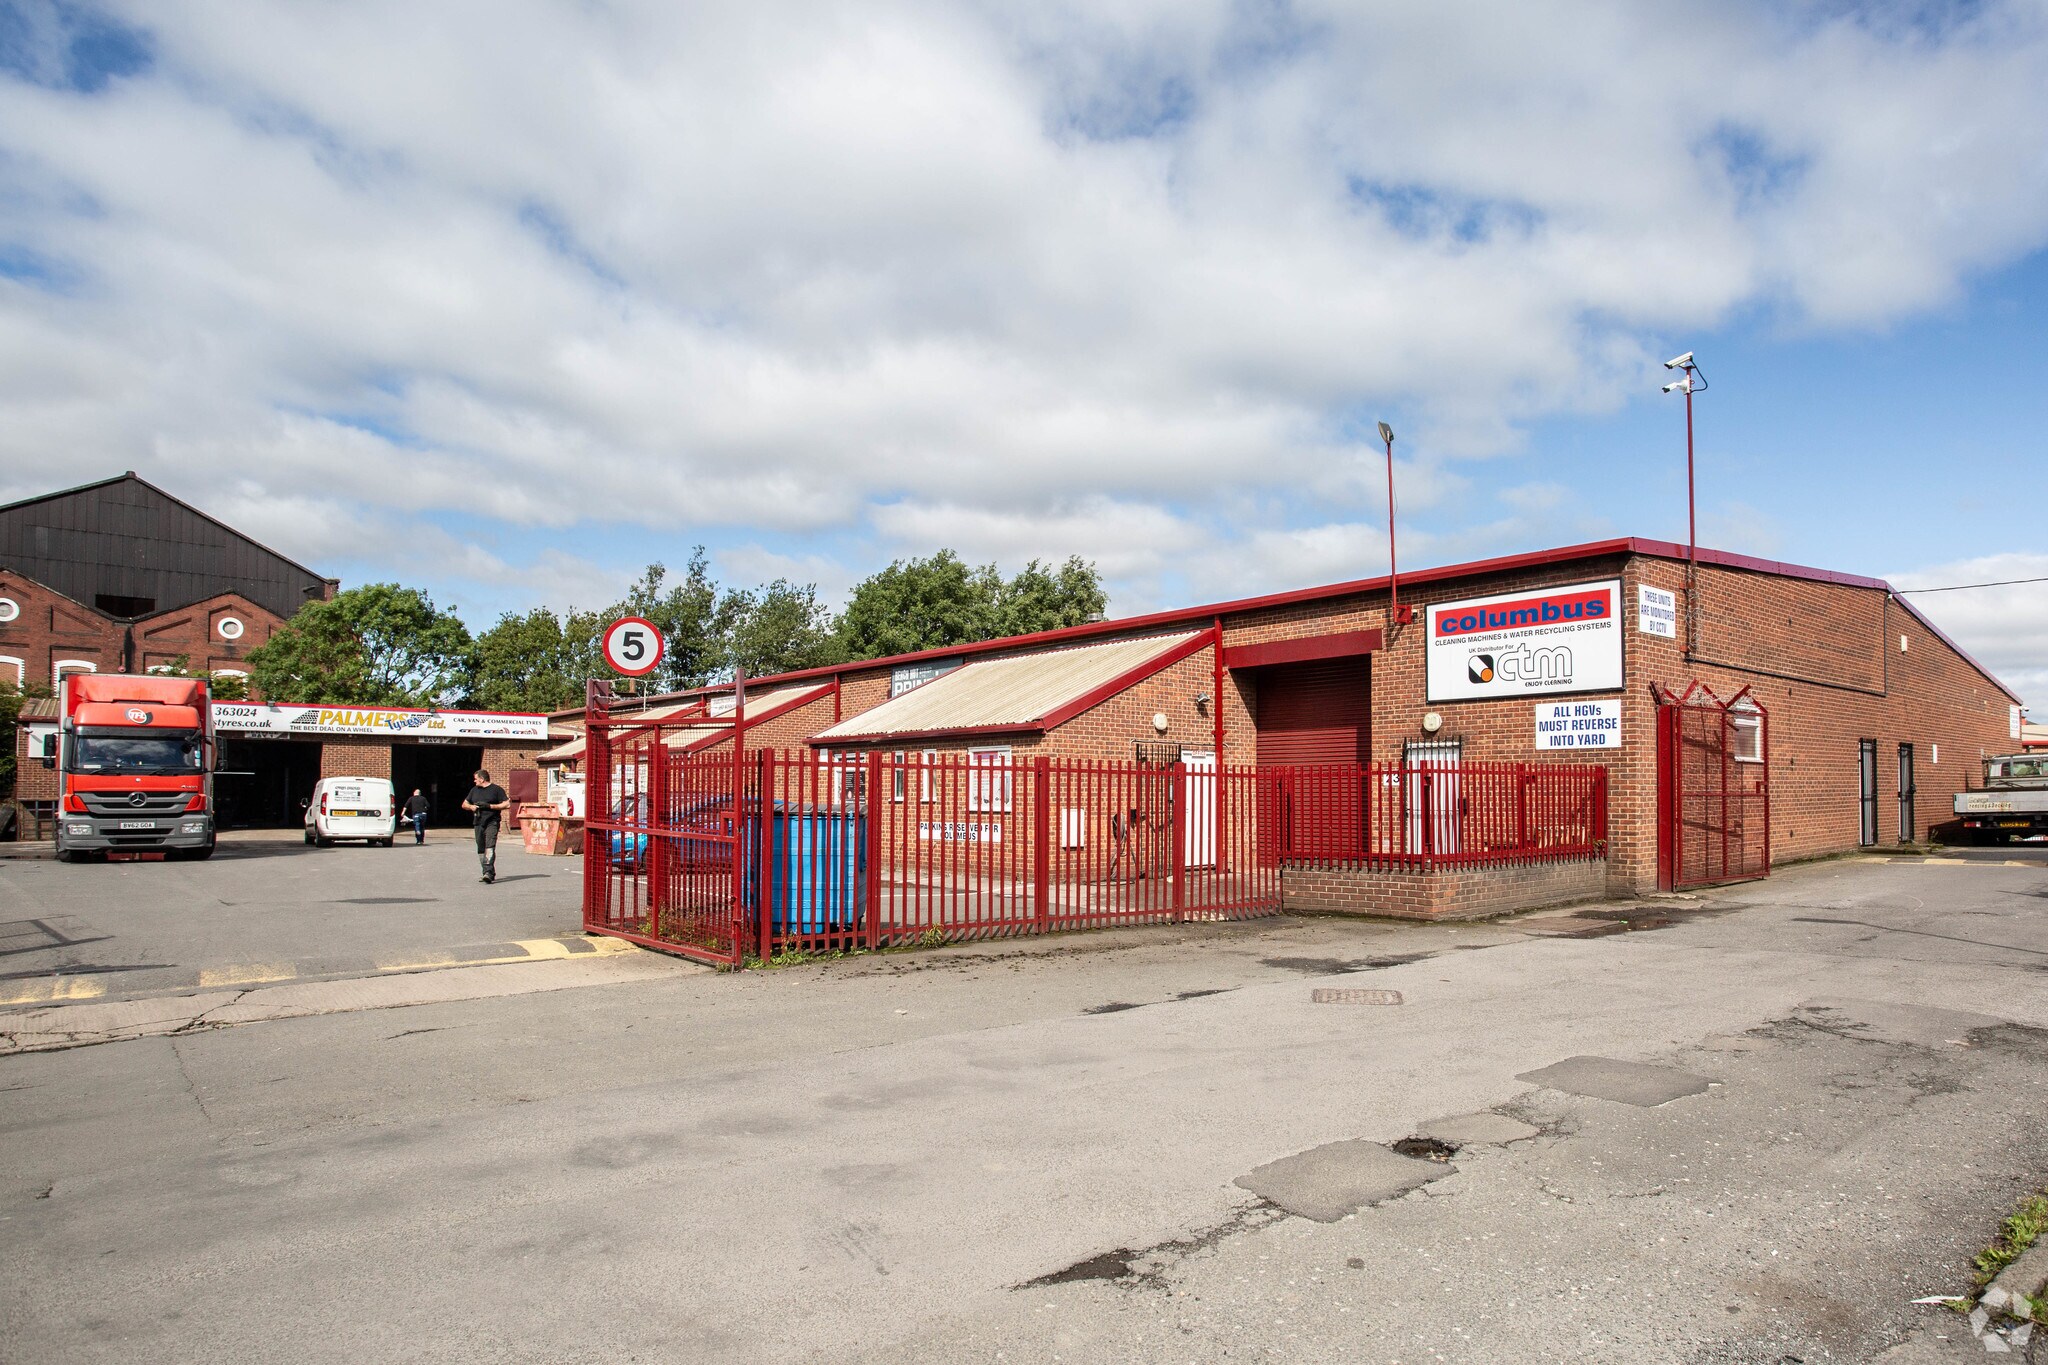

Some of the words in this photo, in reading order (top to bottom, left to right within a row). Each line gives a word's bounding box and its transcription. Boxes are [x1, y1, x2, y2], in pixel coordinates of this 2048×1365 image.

[1645, 591, 1657, 603] THESE
[1658, 594, 1671, 606] UNITS
[1441, 600, 1605, 633] columbus
[1641, 604, 1650, 616] ARE
[1650, 606, 1675, 621] MONITORED
[1650, 620, 1656, 631] BY
[1656, 622, 1667, 633] CCTV
[1435, 637, 1467, 647] CLEANING
[1467, 633, 1502, 643] MACHINES
[1509, 630, 1534, 638] WATER
[1534, 625, 1575, 636] RECYCLING
[1577, 621, 1612, 632] SYSTEMS
[622, 631, 645, 660] 5
[1477, 645, 1504, 653] Distributor
[1496, 643, 1573, 681] ctm
[1543, 678, 1573, 686] CLEANING
[215, 707, 257, 717] 363024
[1553, 706, 1571, 718] ALL
[1574, 704, 1602, 717] HGVs
[318, 709, 409, 728] PALMERS
[385, 717, 420, 731] Tyres
[427, 719, 447, 729] Ltd.
[1538, 720, 1569, 732] MUST
[1571, 717, 1618, 731] REVERSE
[1549, 735, 1574, 747] INTO
[1577, 733, 1606, 746] YARD
[920, 823, 947, 831] PAKING
[984, 824, 999, 833] FR
